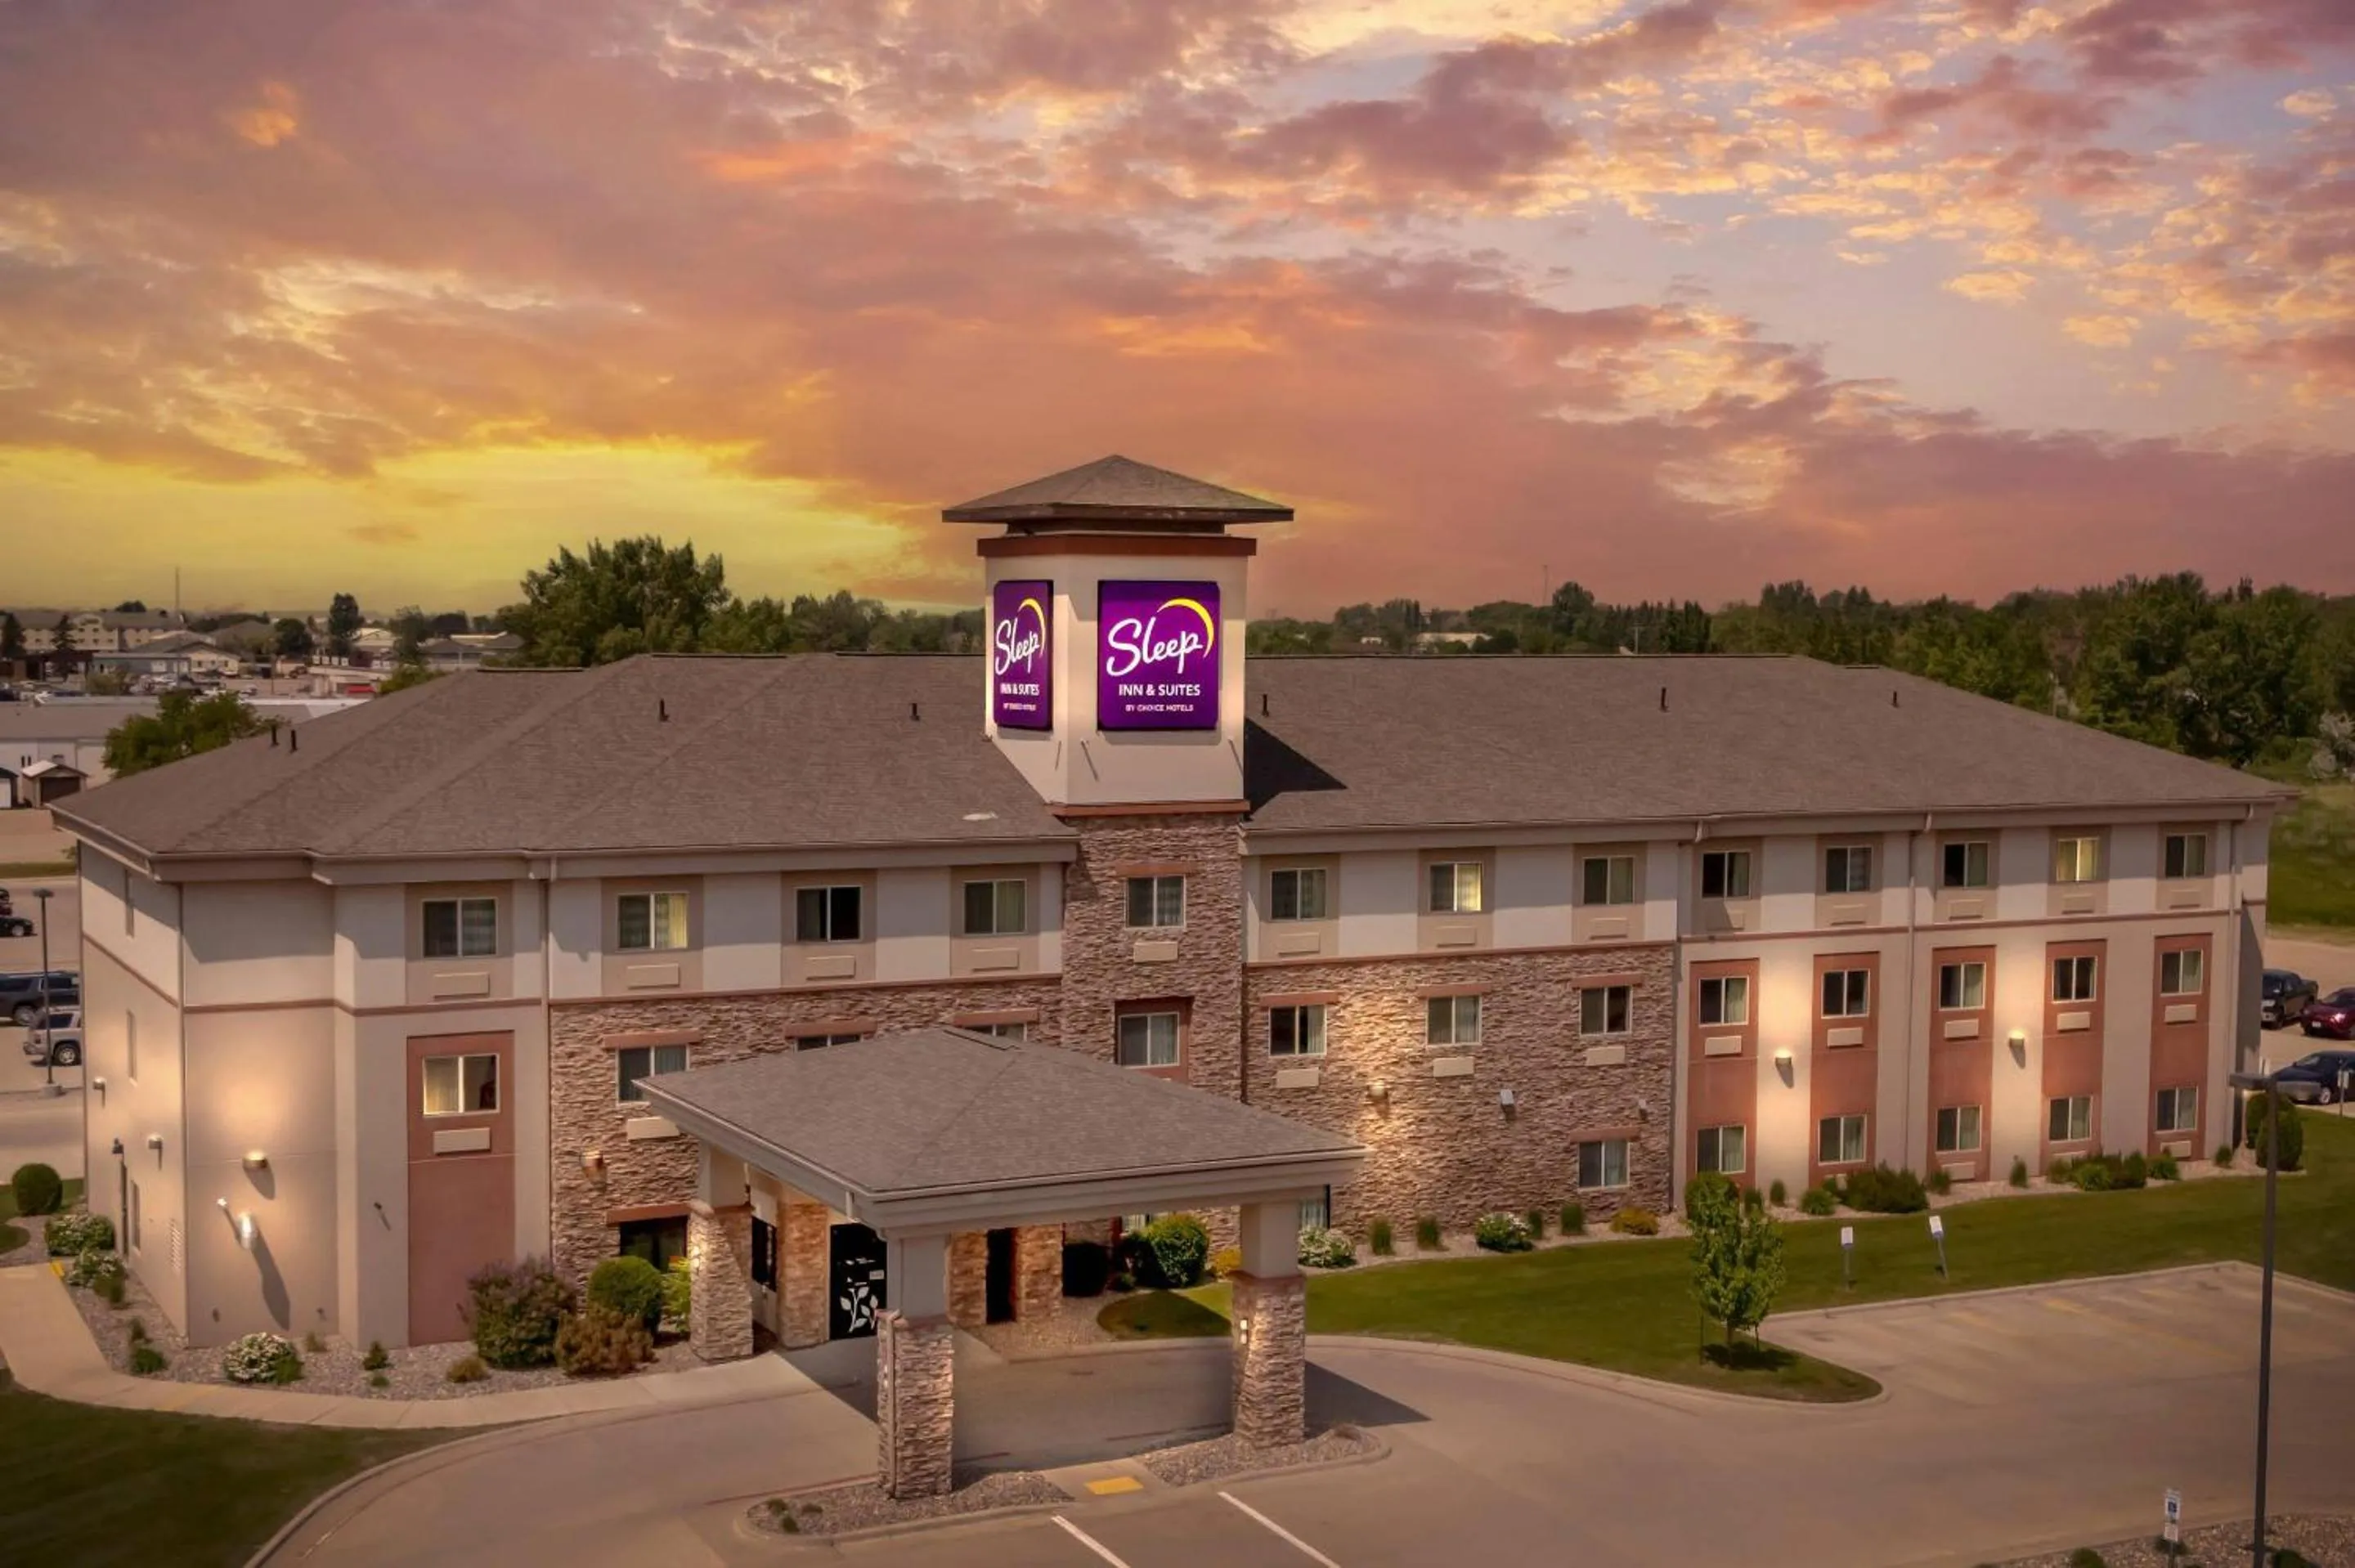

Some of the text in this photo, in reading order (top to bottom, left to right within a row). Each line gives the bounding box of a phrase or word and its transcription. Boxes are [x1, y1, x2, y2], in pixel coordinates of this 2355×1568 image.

[995, 617, 1040, 676] Sleep
[1106, 616, 1204, 677] Sleep
[1119, 683, 1201, 696] INN & SUITES
[1125, 704, 1194, 712] BY CHOICE HOTELS
